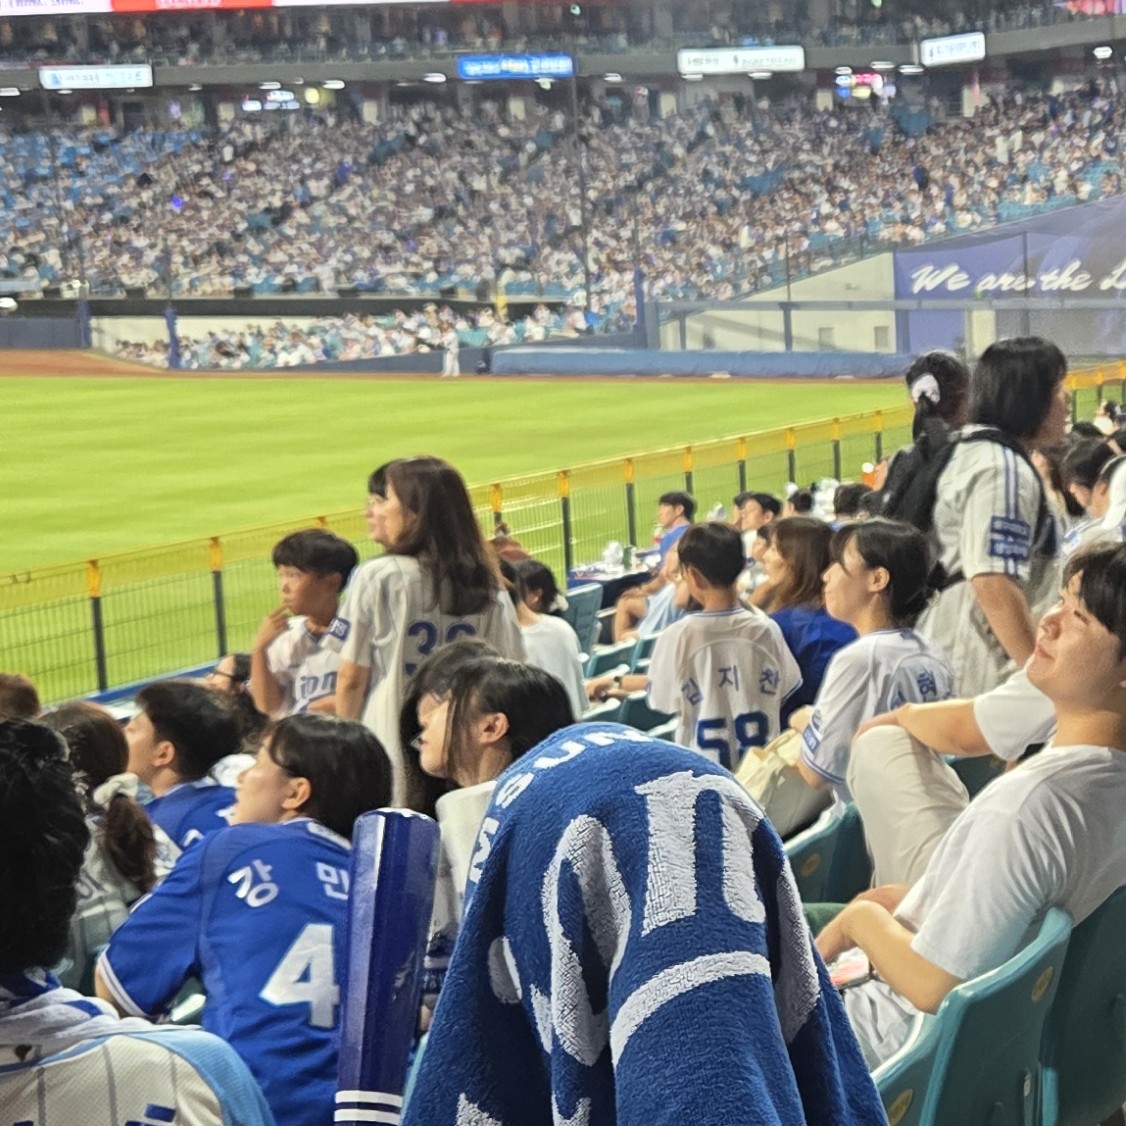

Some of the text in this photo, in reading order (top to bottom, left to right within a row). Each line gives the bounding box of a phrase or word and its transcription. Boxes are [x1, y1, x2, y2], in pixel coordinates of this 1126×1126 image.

[911, 263, 972, 294] We
[975, 271, 1035, 291] are
[1038, 259, 1092, 291] the
[696, 710, 769, 770] 58
